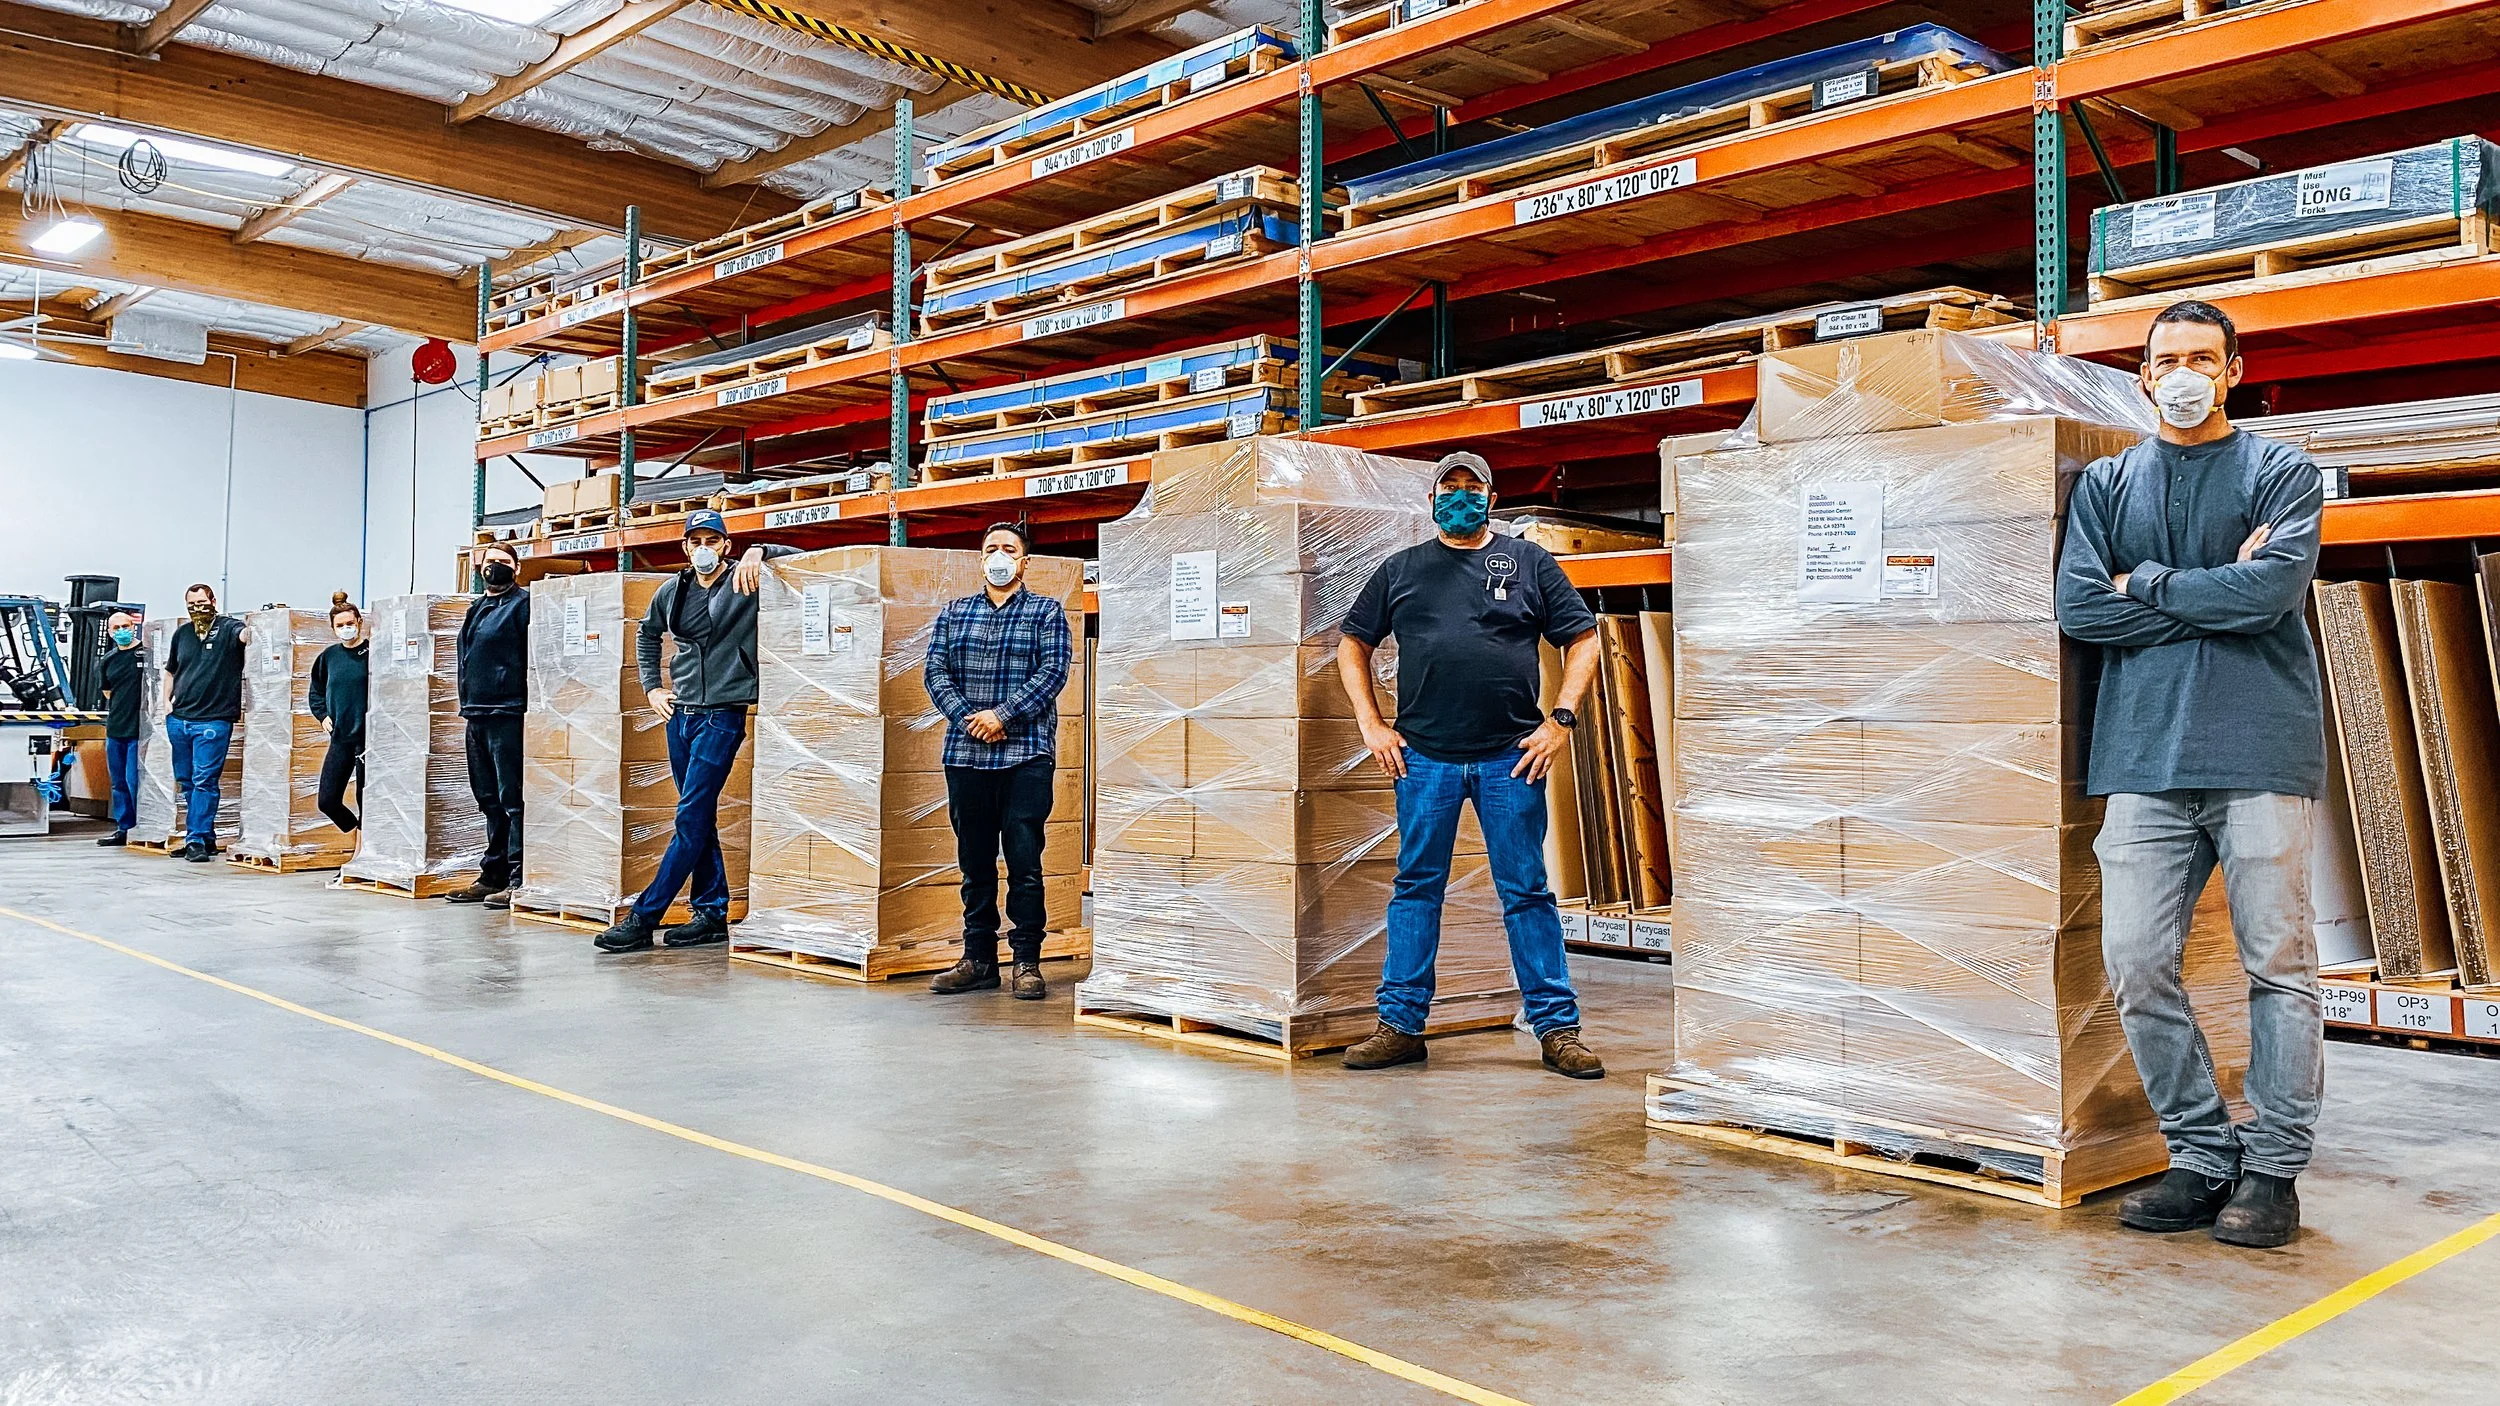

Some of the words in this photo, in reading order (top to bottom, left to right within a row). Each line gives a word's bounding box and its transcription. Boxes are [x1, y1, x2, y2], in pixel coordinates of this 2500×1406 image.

[1042, 153, 1063, 174] .944"
[1063, 155, 1069, 167] x
[1070, 146, 1084, 165] 80"
[1085, 147, 1091, 160] x
[1092, 137, 1110, 157] 120"
[1111, 133, 1122, 151] GP
[2304, 171, 2327, 181] Must
[1530, 193, 1563, 219] .236"
[1566, 195, 1575, 211] x
[1578, 183, 1601, 208] 80"
[1605, 186, 1613, 202] x
[1616, 172, 1646, 199] 120"
[1650, 165, 1679, 190] OP2
[2303, 182, 2320, 190] Use
[2302, 186, 2352, 206] LONG
[2301, 206, 2326, 215] Forks
[736, 262, 741, 271] x
[767, 247, 776, 261] GP
[1054, 320, 1060, 331] x
[1076, 315, 1081, 326] x
[1101, 303, 1113, 320] GP
[771, 380, 778, 393] GP
[1539, 401, 1573, 424] .944"
[1576, 404, 1584, 419] x
[1588, 394, 1612, 417] 80"
[1615, 398, 1623, 414] x
[1627, 388, 1658, 412] 120"
[1661, 385, 1680, 407] GP
[1036, 477, 1056, 494] .708"
[1057, 480, 1062, 491] x
[1063, 474, 1077, 490] 80"
[1079, 476, 1084, 488] x
[1086, 470, 1103, 487] 120"
[1105, 468, 1116, 484] GP
[821, 506, 830, 519] GP
[1490, 560, 1512, 570] api
[1561, 916, 1574, 924] GP
[1592, 919, 1626, 931] Acrycast
[1635, 923, 1671, 936] Acrycast
[2397, 996, 2429, 1010] OP3
[2397, 1014, 2432, 1027] .118"
